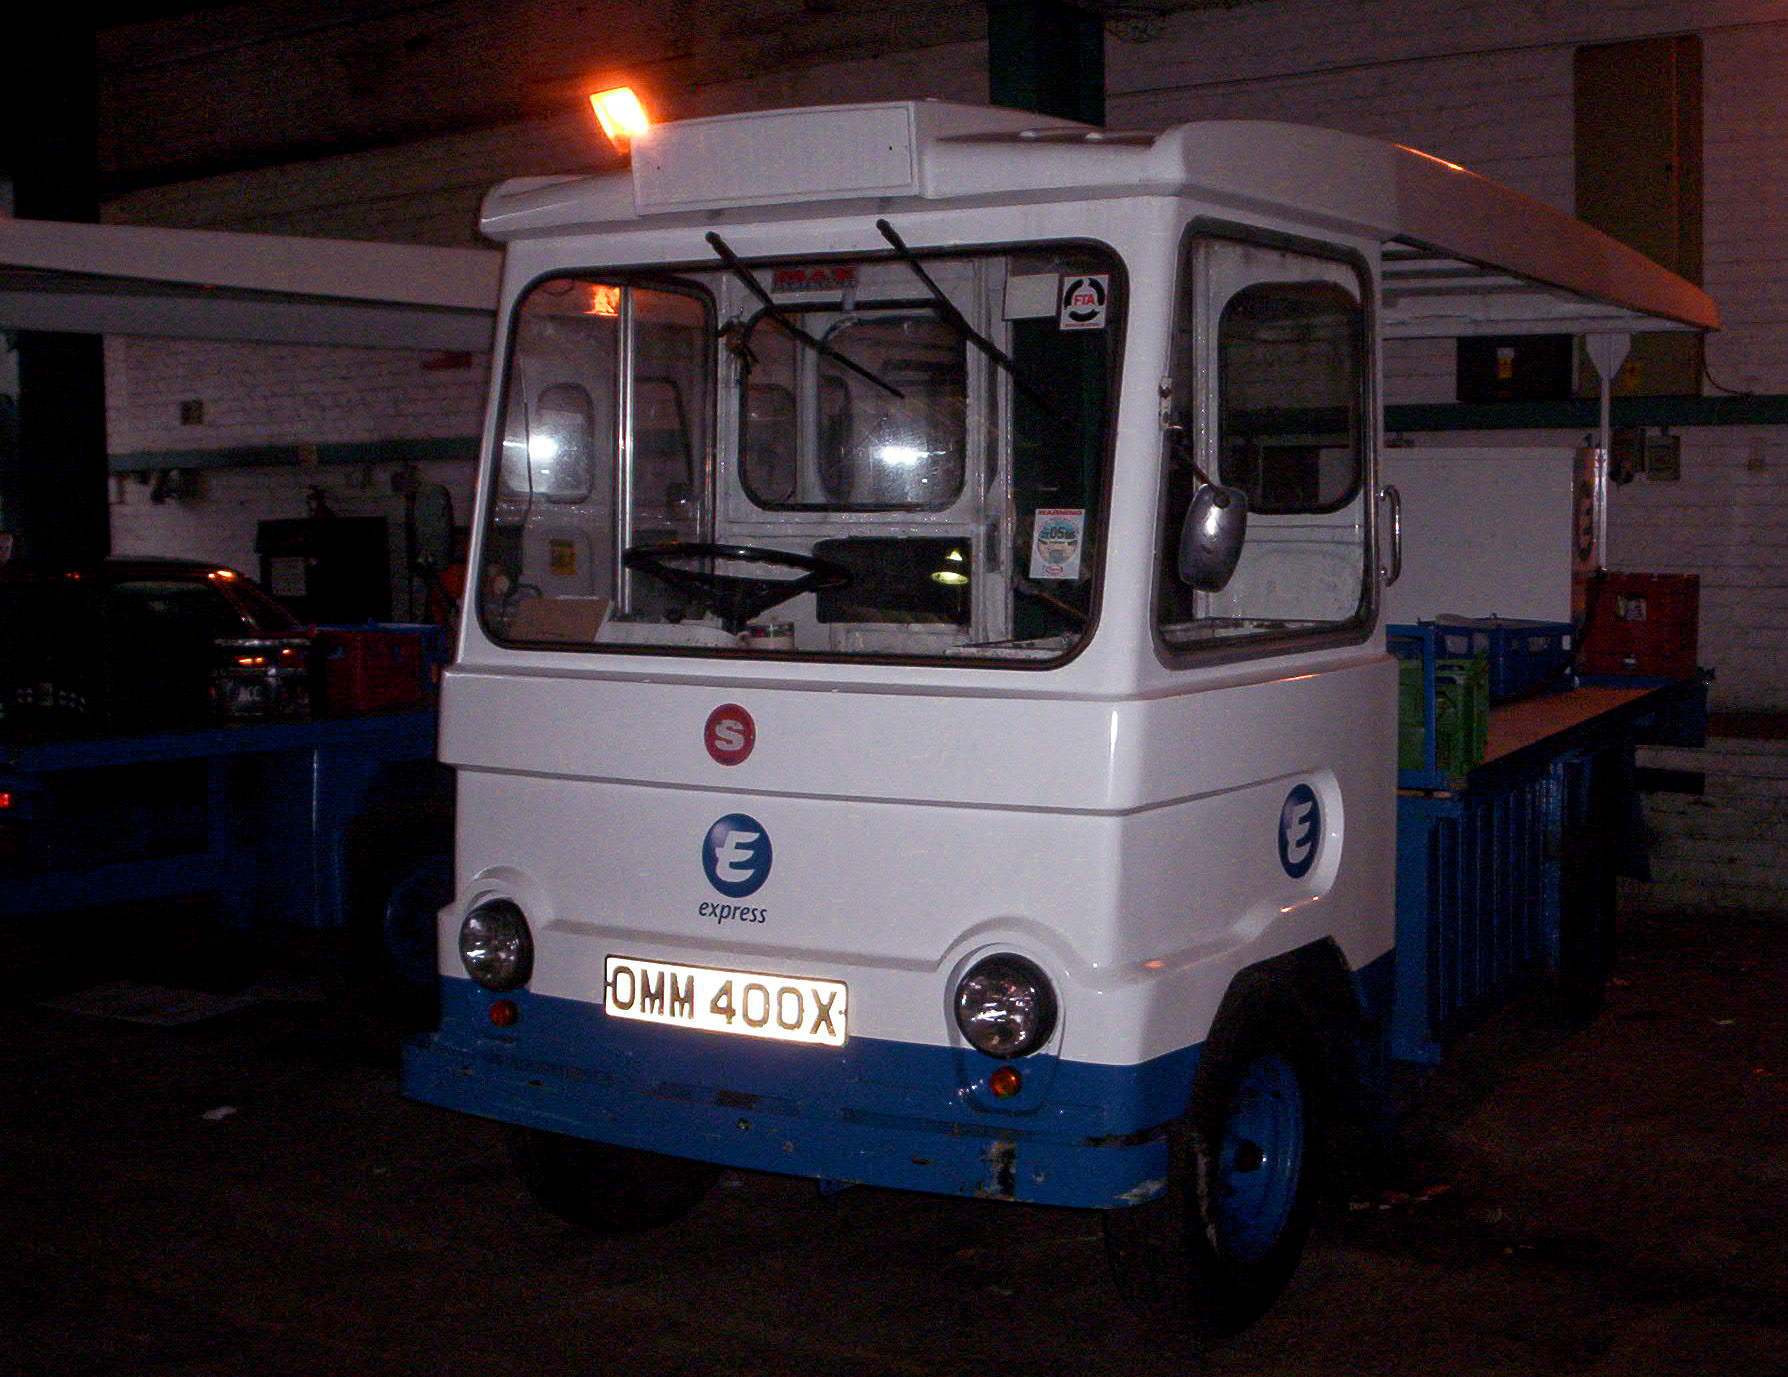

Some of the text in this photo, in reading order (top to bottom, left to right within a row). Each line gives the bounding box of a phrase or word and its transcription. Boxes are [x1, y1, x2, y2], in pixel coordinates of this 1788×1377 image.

[1073, 293, 1097, 306] FTA
[715, 719, 746, 751] S
[714, 830, 761, 883] E
[698, 901, 768, 924] express
[612, 965, 838, 1037] OMM 400X
